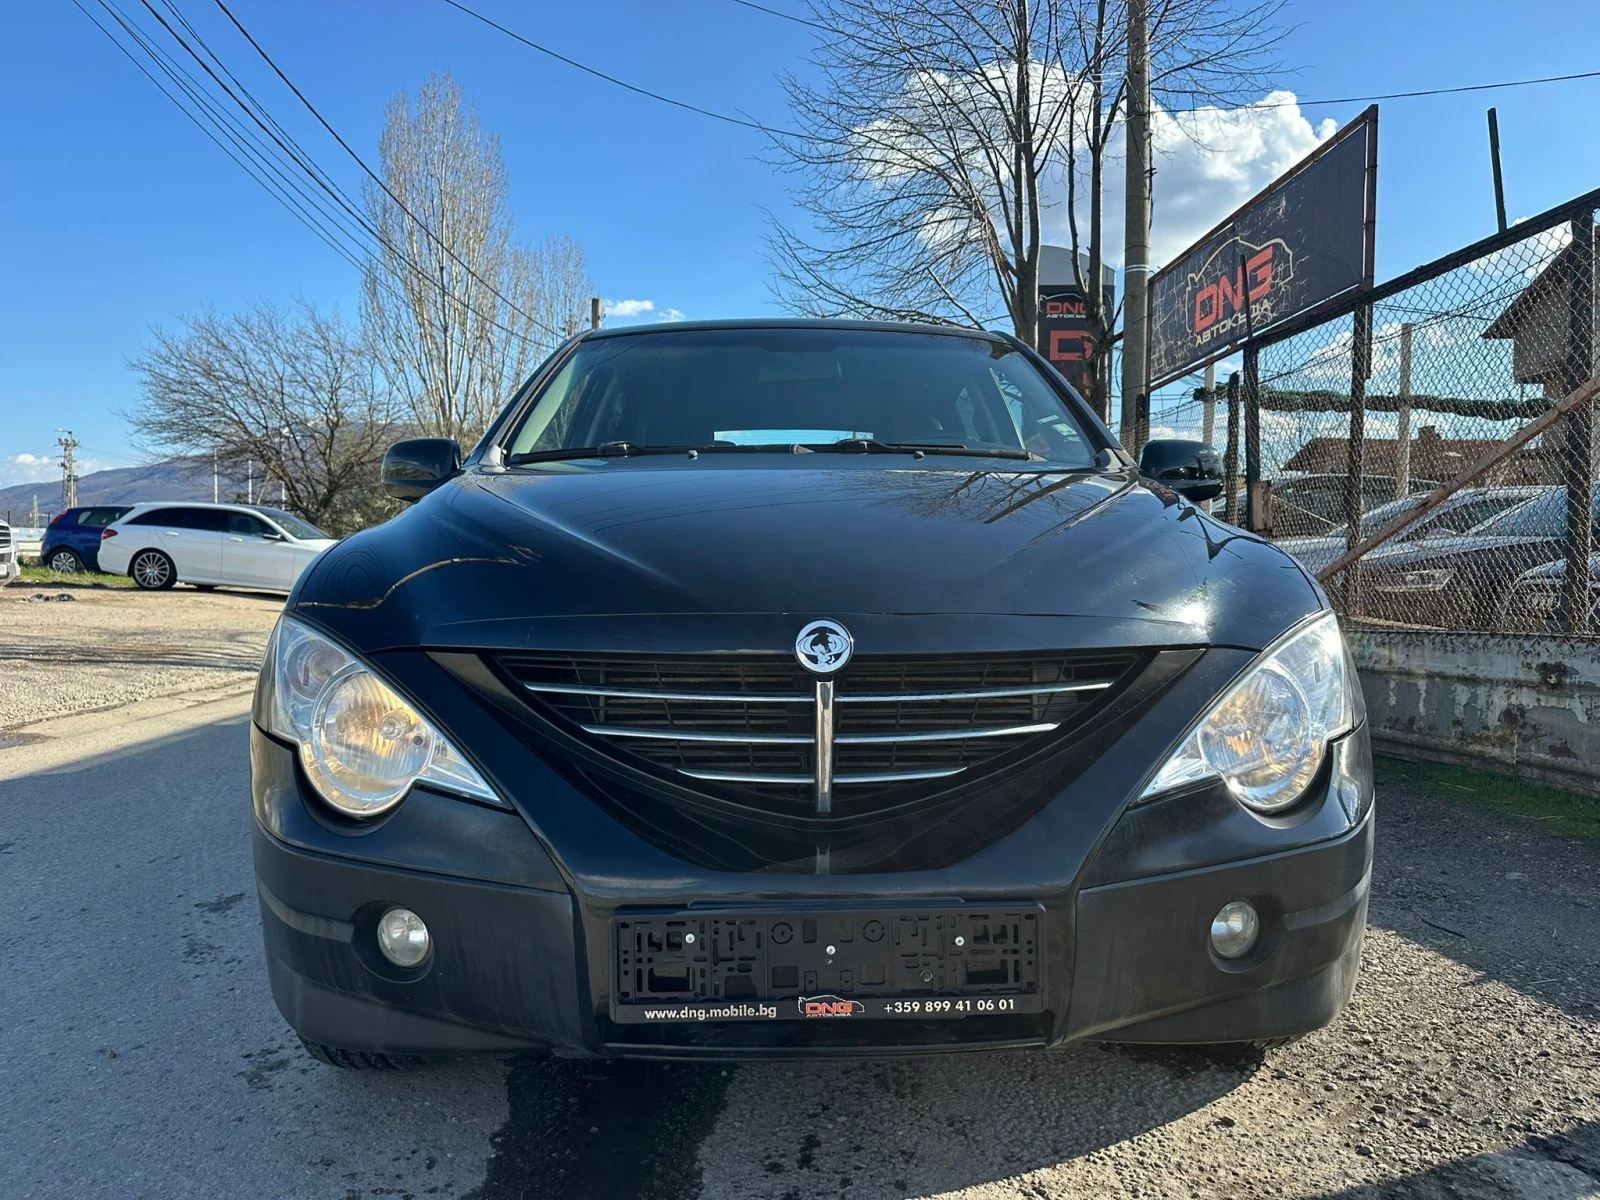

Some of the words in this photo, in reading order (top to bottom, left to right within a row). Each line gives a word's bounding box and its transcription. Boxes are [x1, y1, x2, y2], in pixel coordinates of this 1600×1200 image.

[1195, 246, 1273, 333] DNG
[644, 1003, 777, 1020] www.dng.mobile.bg
[805, 1002, 853, 1014] DNG
[884, 1001, 920, 1013] +359
[925, 1000, 951, 1012] 899
[955, 1000, 971, 1011] 41
[977, 999, 995, 1011] 06
[998, 998, 1014, 1010] 01
